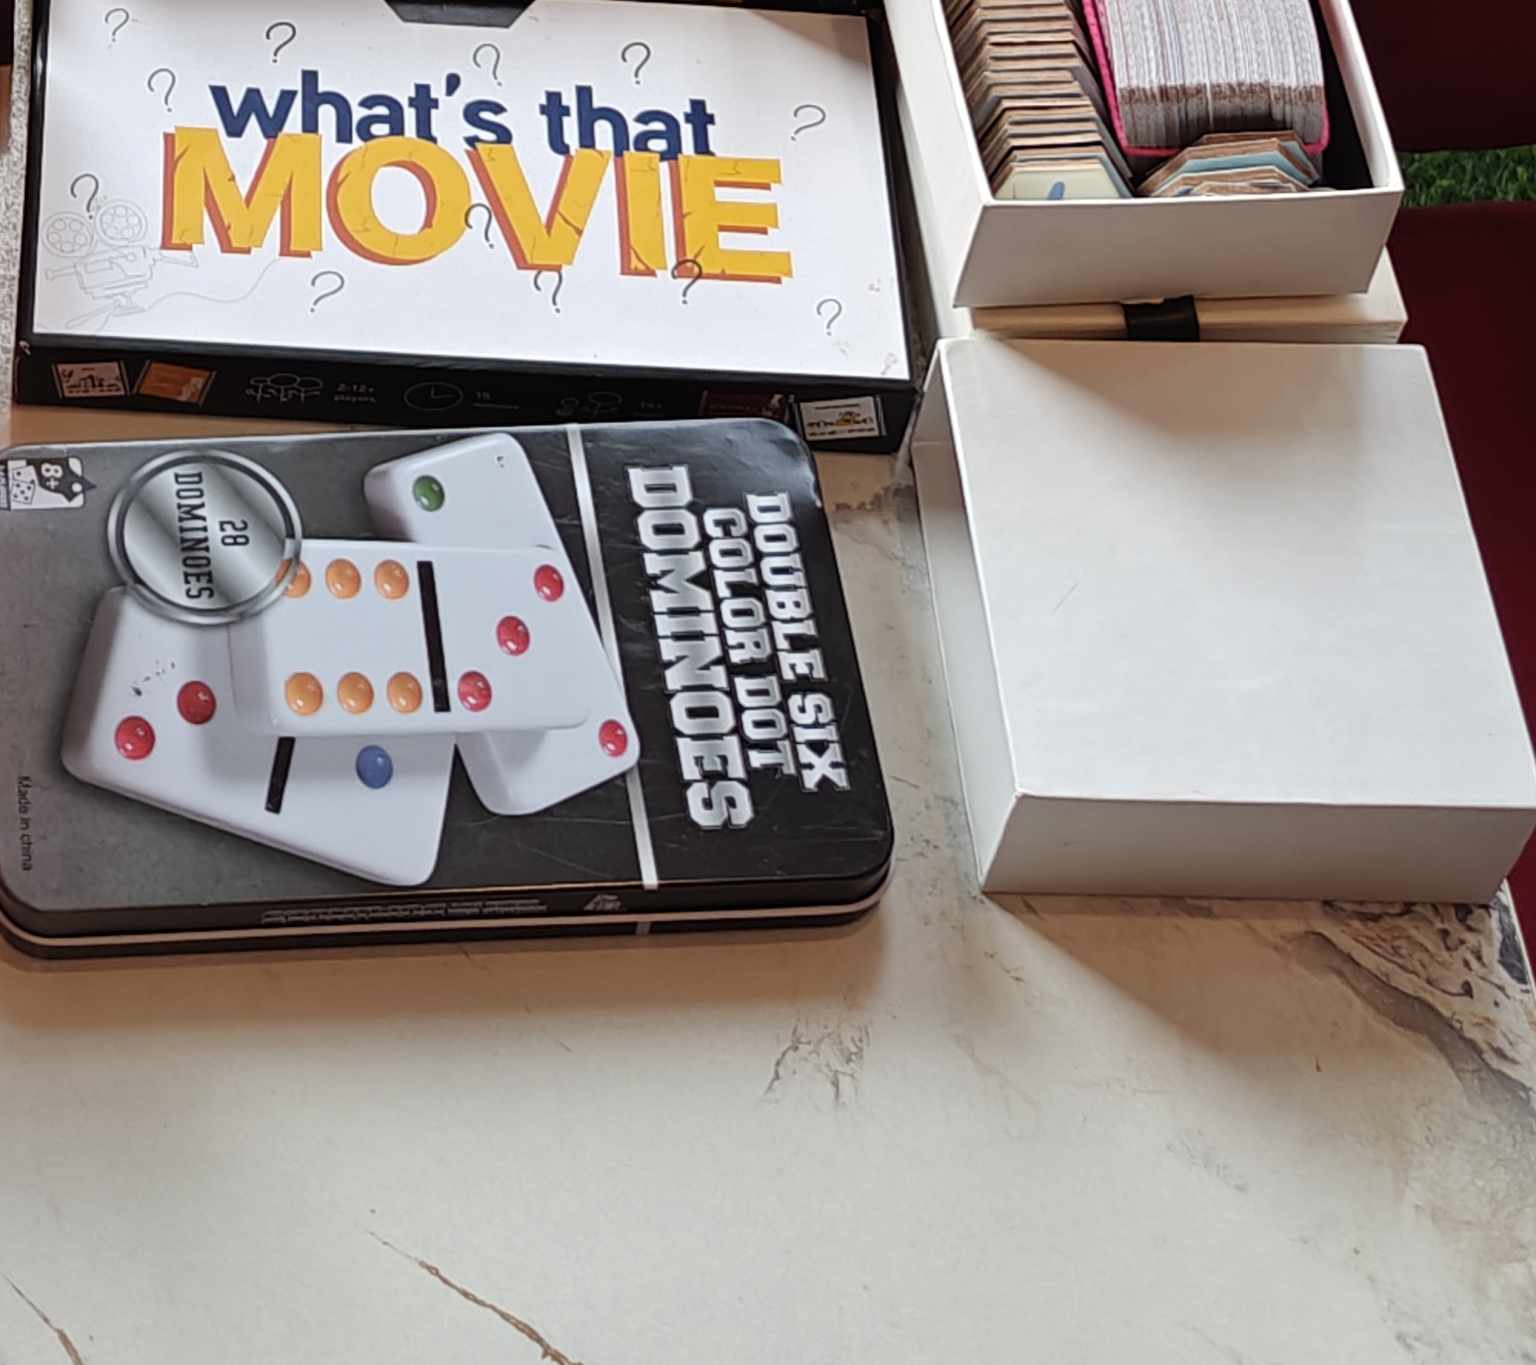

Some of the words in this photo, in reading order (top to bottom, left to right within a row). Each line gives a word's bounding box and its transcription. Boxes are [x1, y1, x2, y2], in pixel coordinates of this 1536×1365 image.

[208, 68, 512, 147] what's
[539, 85, 718, 160] that
[159, 125, 794, 285] MOVIE
[40, 463, 63, 491] 8+
[172, 470, 215, 601] DOMINOES
[217, 518, 251, 548] 28
[702, 506, 773, 666] COLOR
[625, 464, 756, 830] DOMINOES
[745, 491, 828, 683] DOUBLE
[787, 691, 852, 792] SIX
[732, 673, 797, 776] DOT
[18, 775, 32, 810] Made
[18, 834, 33, 873] china
